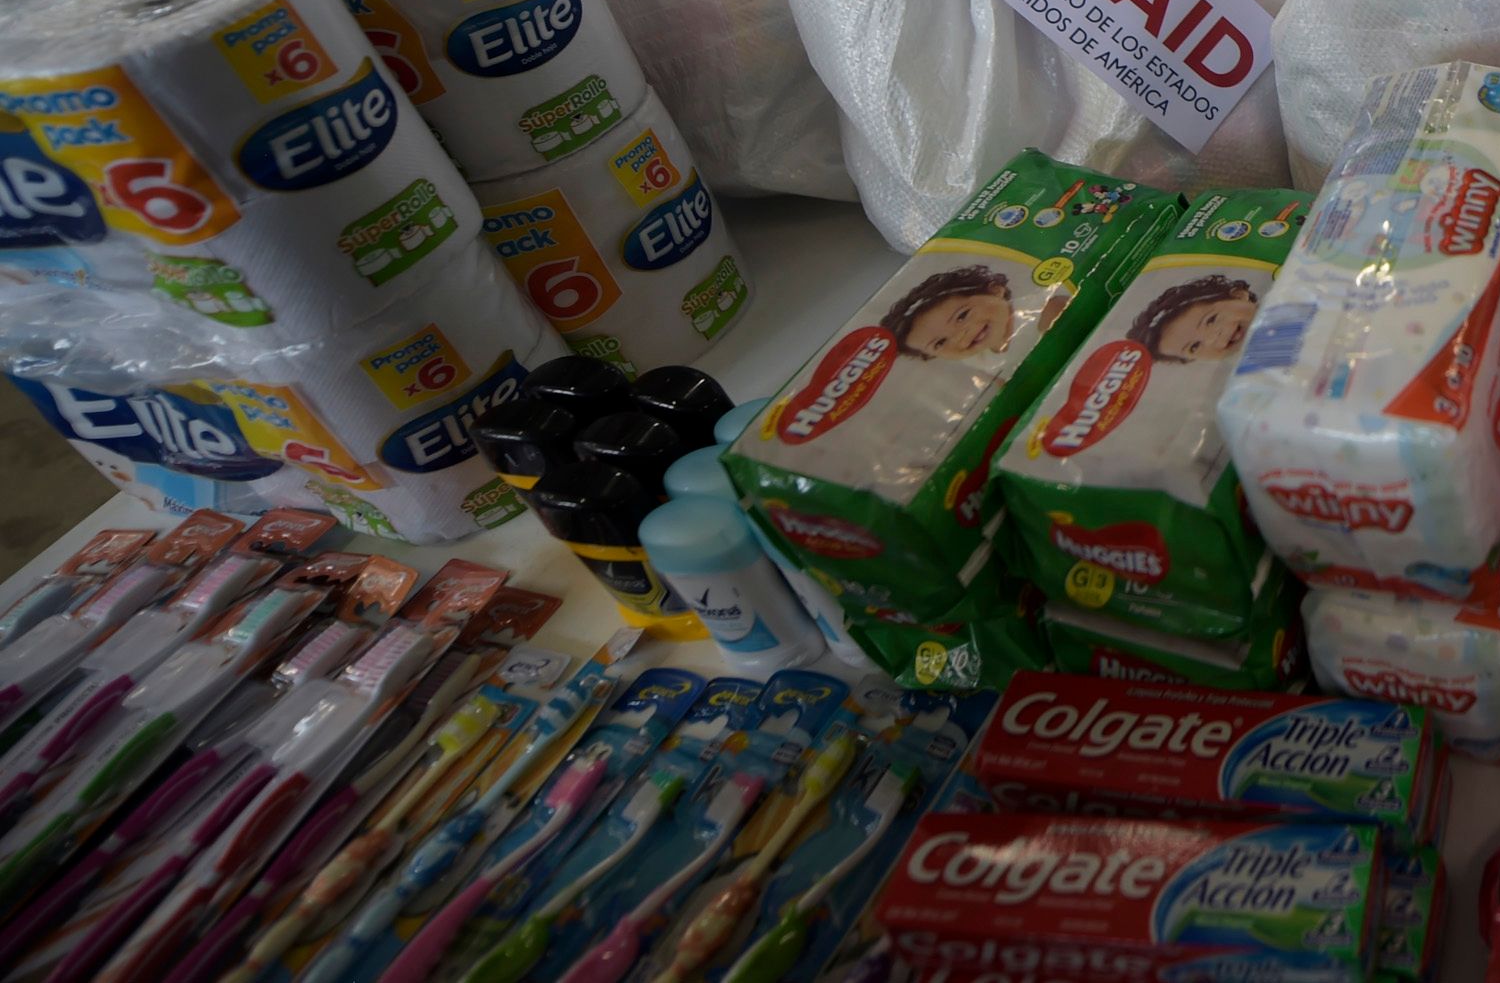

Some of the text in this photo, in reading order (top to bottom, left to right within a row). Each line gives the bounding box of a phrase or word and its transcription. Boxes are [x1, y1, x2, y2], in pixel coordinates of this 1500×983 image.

[223, 7, 289, 48] Promo
[251, 19, 297, 56] pack
[263, 39, 320, 87] x6
[1068, 28, 1096, 54] DE
[1094, 50, 1171, 117] AMÉRICA
[1085, 5, 1112, 32] DE
[1111, 25, 1145, 61] LOS
[1145, 54, 1220, 122] ESTADOS
[269, 88, 391, 181] Elite
[614, 135, 653, 169] Promo
[630, 143, 658, 174] pack
[639, 156, 672, 195] x6
[481, 205, 555, 233] omo
[638, 188, 710, 263] Elite
[496, 228, 560, 259] ack
[1060, 239, 1081, 255] 10
[370, 332, 434, 370] Promo
[394, 341, 441, 375] pack
[403, 355, 457, 398] x6
[786, 335, 892, 438] HUGGIES
[1054, 348, 1142, 448] HUGGIES
[44, 382, 236, 458] Elite
[1268, 484, 1412, 532] winny
[1055, 528, 1164, 576] HUGGIES
[1071, 565, 1091, 589] G
[1346, 668, 1475, 711] winny
[1001, 690, 1233, 759] Colgate
[1283, 716, 1366, 751] Triple
[1248, 741, 1350, 777] Acción
[906, 830, 1167, 906] Colgate
[1222, 845, 1313, 882] Triple
[1180, 877, 1297, 909] Acción
